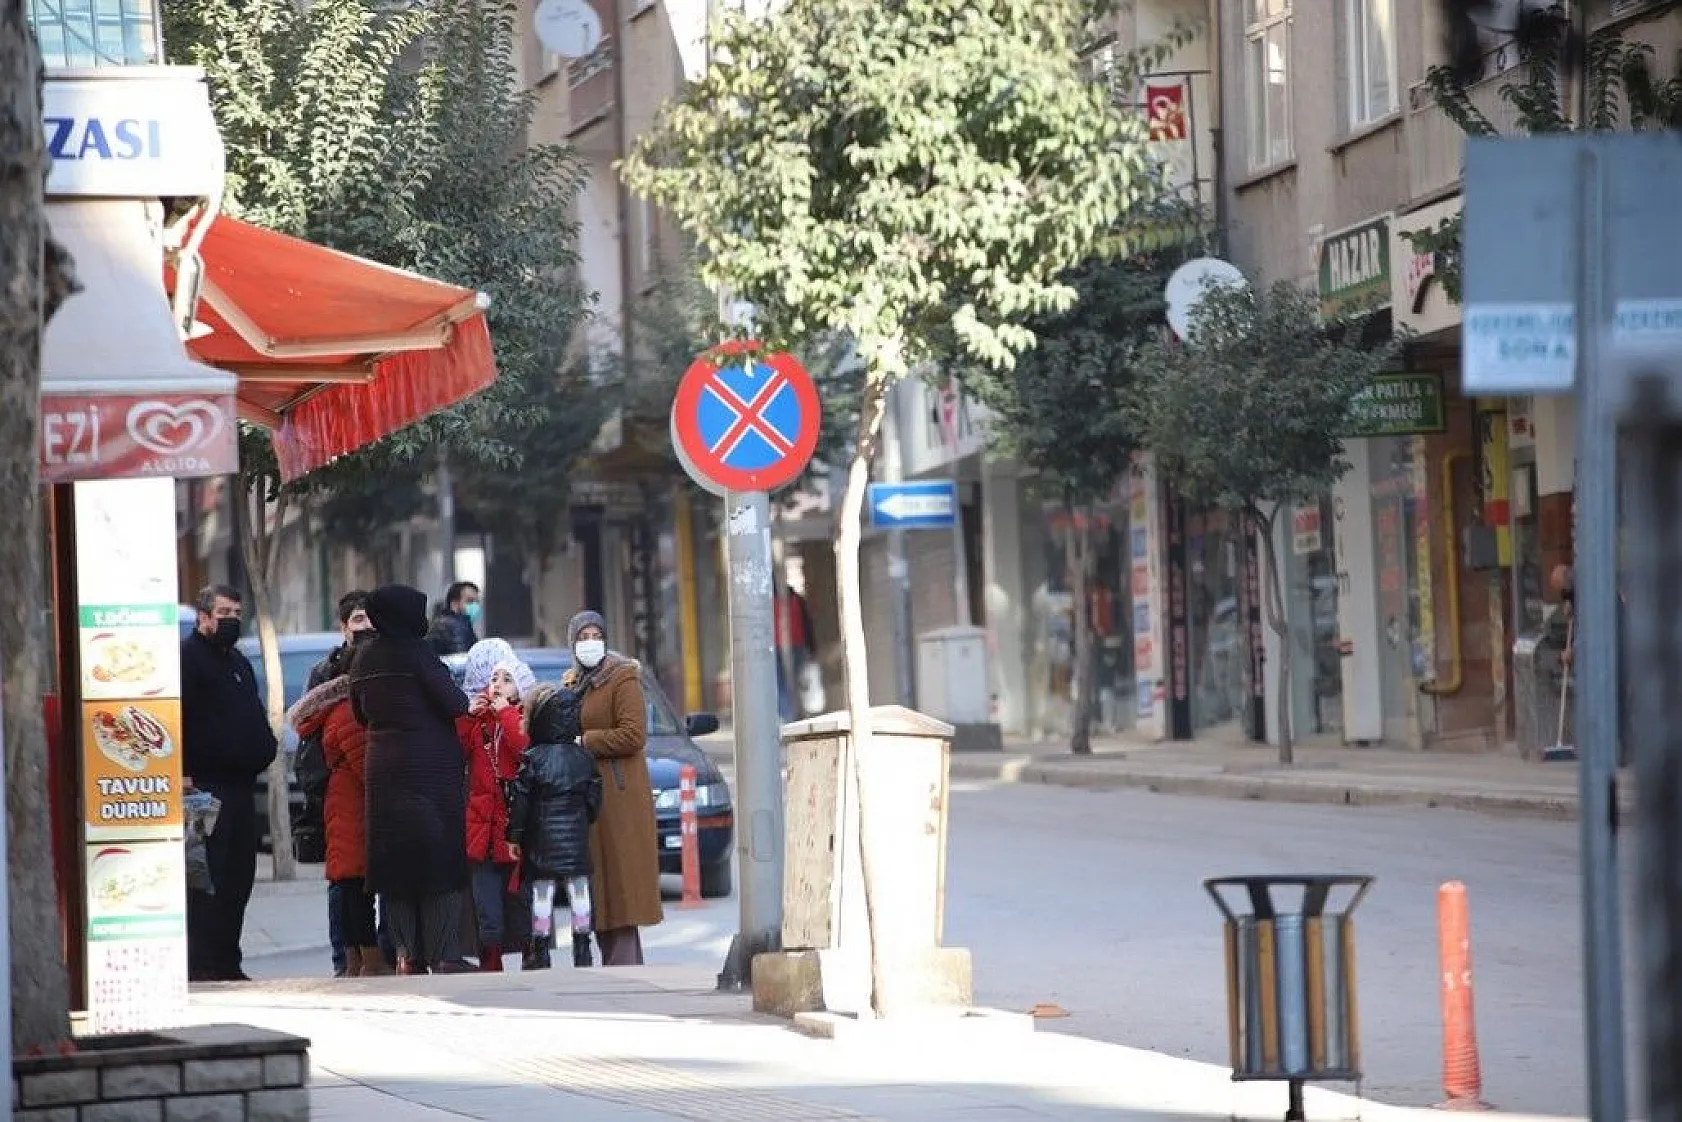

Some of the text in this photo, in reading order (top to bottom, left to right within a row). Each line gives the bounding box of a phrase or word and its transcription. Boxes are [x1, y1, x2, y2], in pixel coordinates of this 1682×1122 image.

[44, 118, 160, 160] ZASI
[45, 404, 99, 464] EZİ
[141, 457, 211, 472] ALGIDA
[98, 776, 170, 796] TAVUK
[101, 797, 168, 819] DÜRÜM
